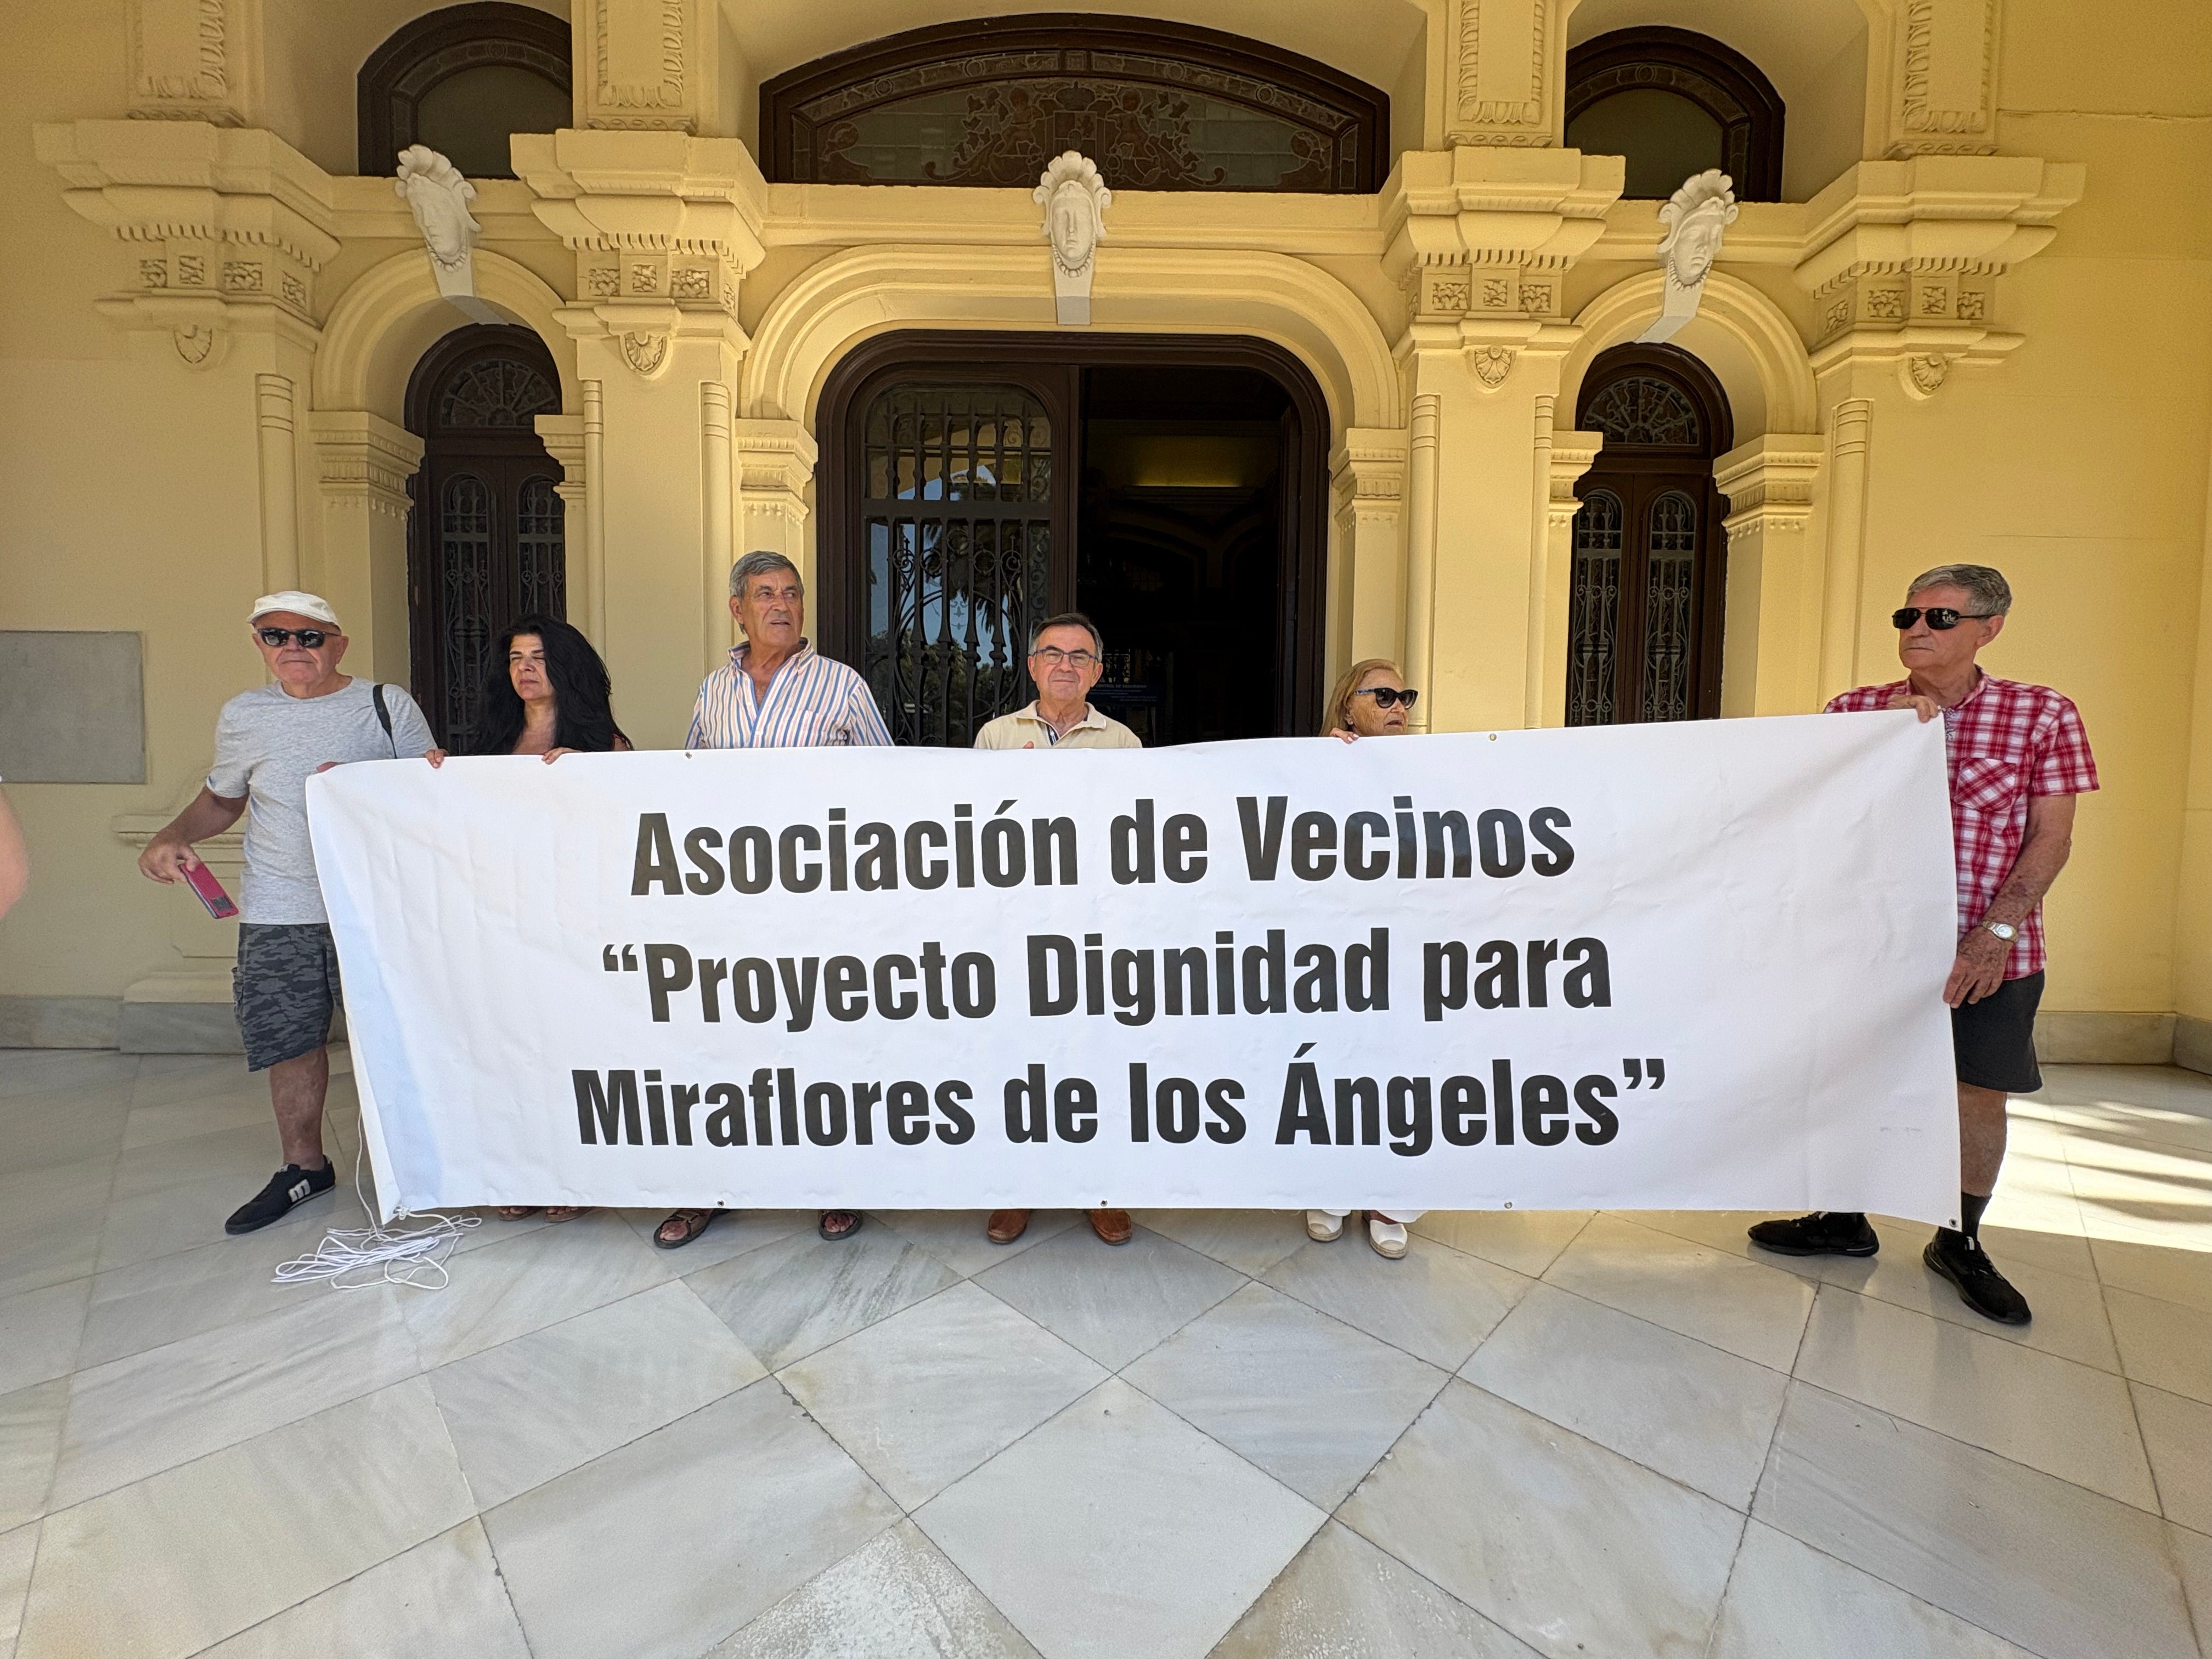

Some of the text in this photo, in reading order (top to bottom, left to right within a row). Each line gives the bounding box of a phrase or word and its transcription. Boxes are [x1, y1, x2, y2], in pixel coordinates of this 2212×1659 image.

[631, 795, 1575, 896] Asociación de Vecinos
[602, 927, 1612, 1032] “Proyecto Dignidad para
[572, 1042, 1665, 1157] Miraflores de los Ángeles”
